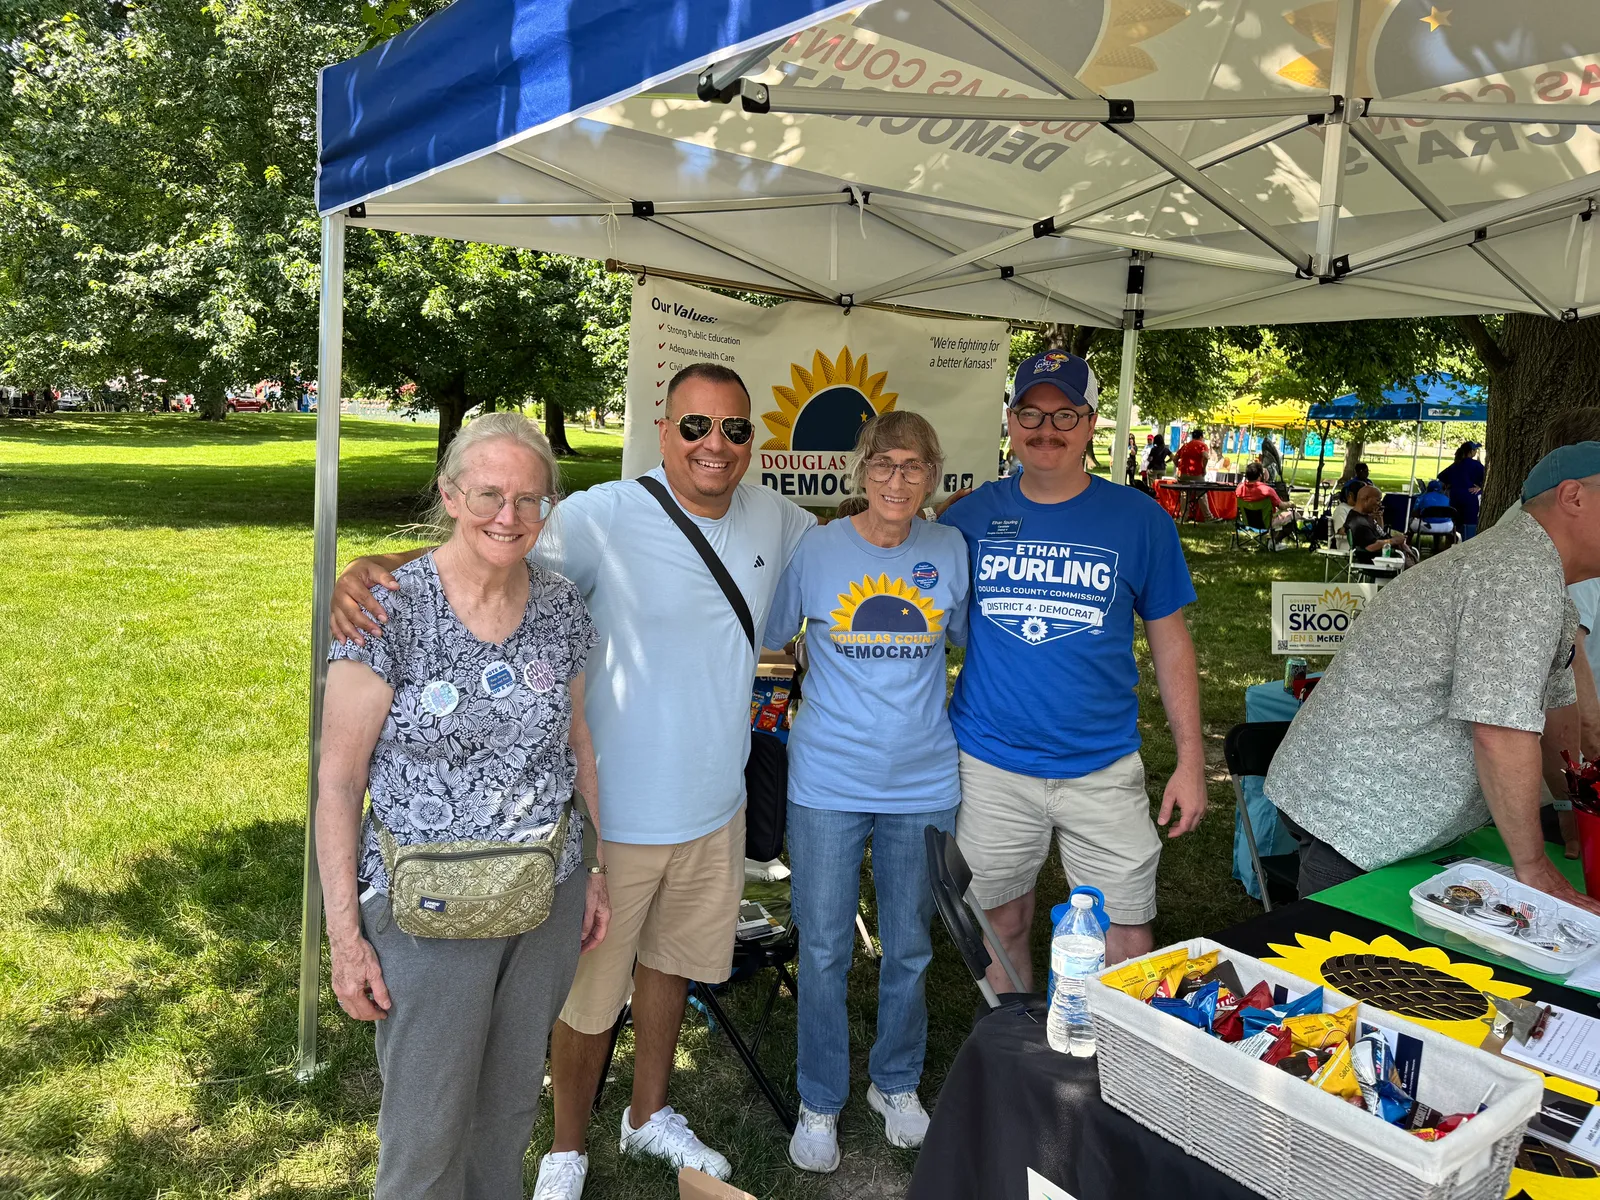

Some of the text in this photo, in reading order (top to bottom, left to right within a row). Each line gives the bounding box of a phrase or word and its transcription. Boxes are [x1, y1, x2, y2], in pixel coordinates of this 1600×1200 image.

[651, 297, 718, 324] Our Values:
[667, 324, 741, 345] Strong Public Education
[669, 343, 735, 362] Adequate Health Care
[957, 337, 988, 353] fighting
[988, 339, 1000, 352] for
[669, 361, 682, 371] Civil
[929, 356, 997, 370] a better Kansas!"
[760, 453, 847, 470] DOUGLAS
[761, 473, 862, 496] DEMOC
[1016, 543, 1071, 558] ETHAN
[978, 554, 1111, 591] SPURLING
[978, 585, 1107, 603] DOUGLAS COUNTY COMMISSION
[987, 602, 1094, 620] DISTRICT 4 DEMOCRAT
[1289, 604, 1317, 612] CURT
[1289, 613, 1349, 631] SKOO
[830, 633, 941, 645] DOUGLAS COUNT
[834, 642, 938, 659] DEMOCRAT
[485, 667, 498, 677] VOTE
[526, 659, 549, 680] GOOD
